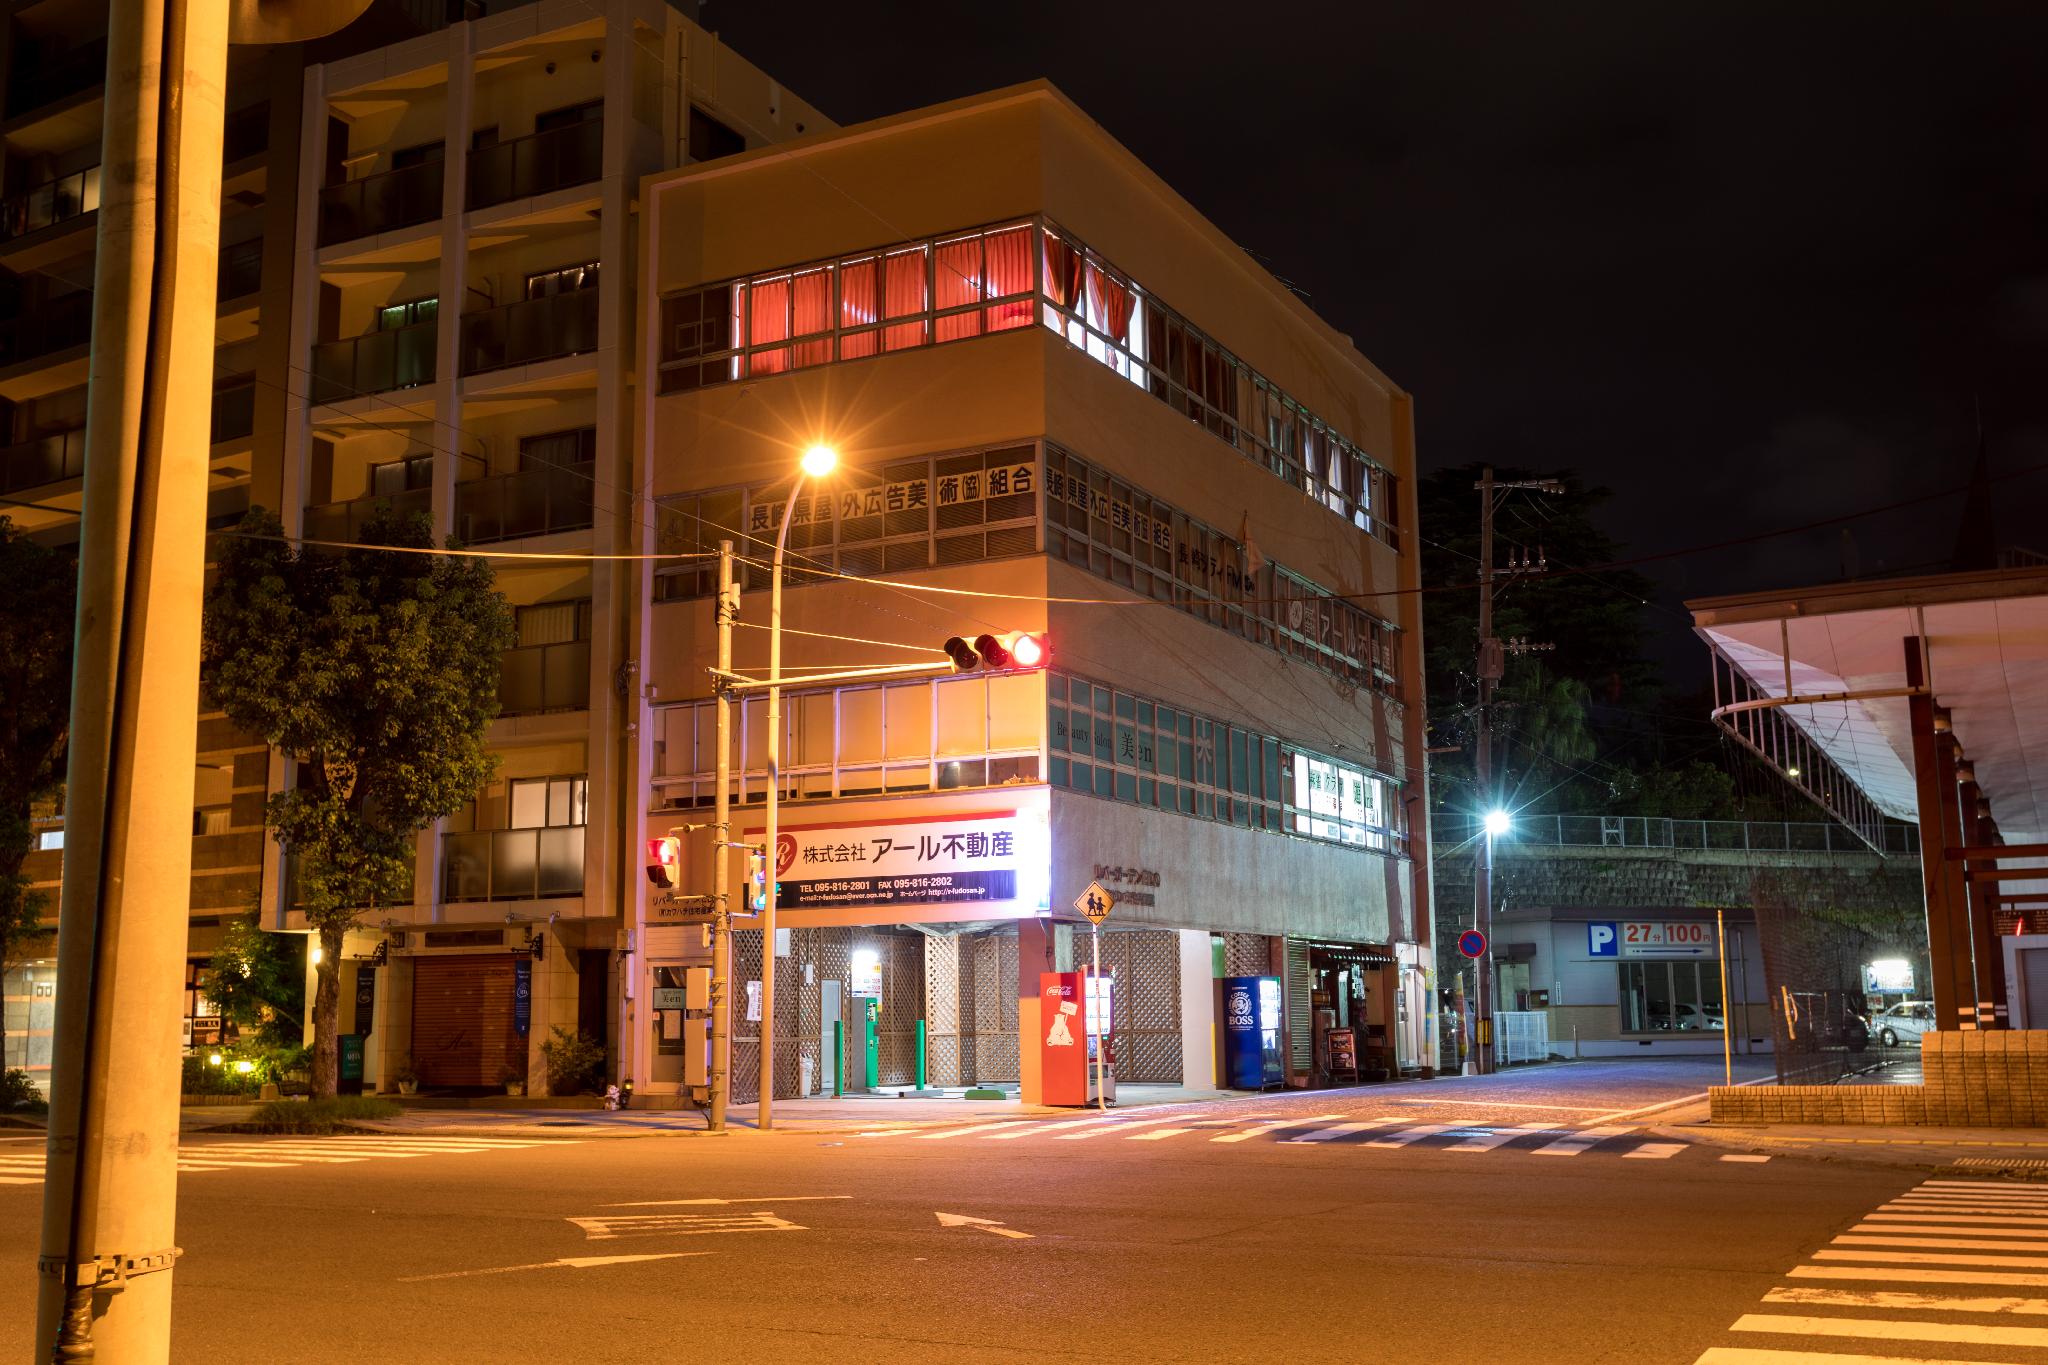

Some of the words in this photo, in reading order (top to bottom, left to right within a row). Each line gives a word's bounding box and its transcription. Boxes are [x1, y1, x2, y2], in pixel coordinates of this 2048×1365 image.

[803, 843, 867, 864] 株式会社
[872, 831, 1014, 863] アール不動産
[800, 884, 813, 893] TEL
[814, 881, 870, 892] 095-816-2801
[878, 880, 892, 890] FAX
[894, 877, 953, 888] 095-816-2802
[1590, 925, 1614, 953] P
[1626, 924, 1661, 943] 27分
[1666, 924, 1711, 943] 100円
[1229, 1015, 1254, 1025] BOSS
